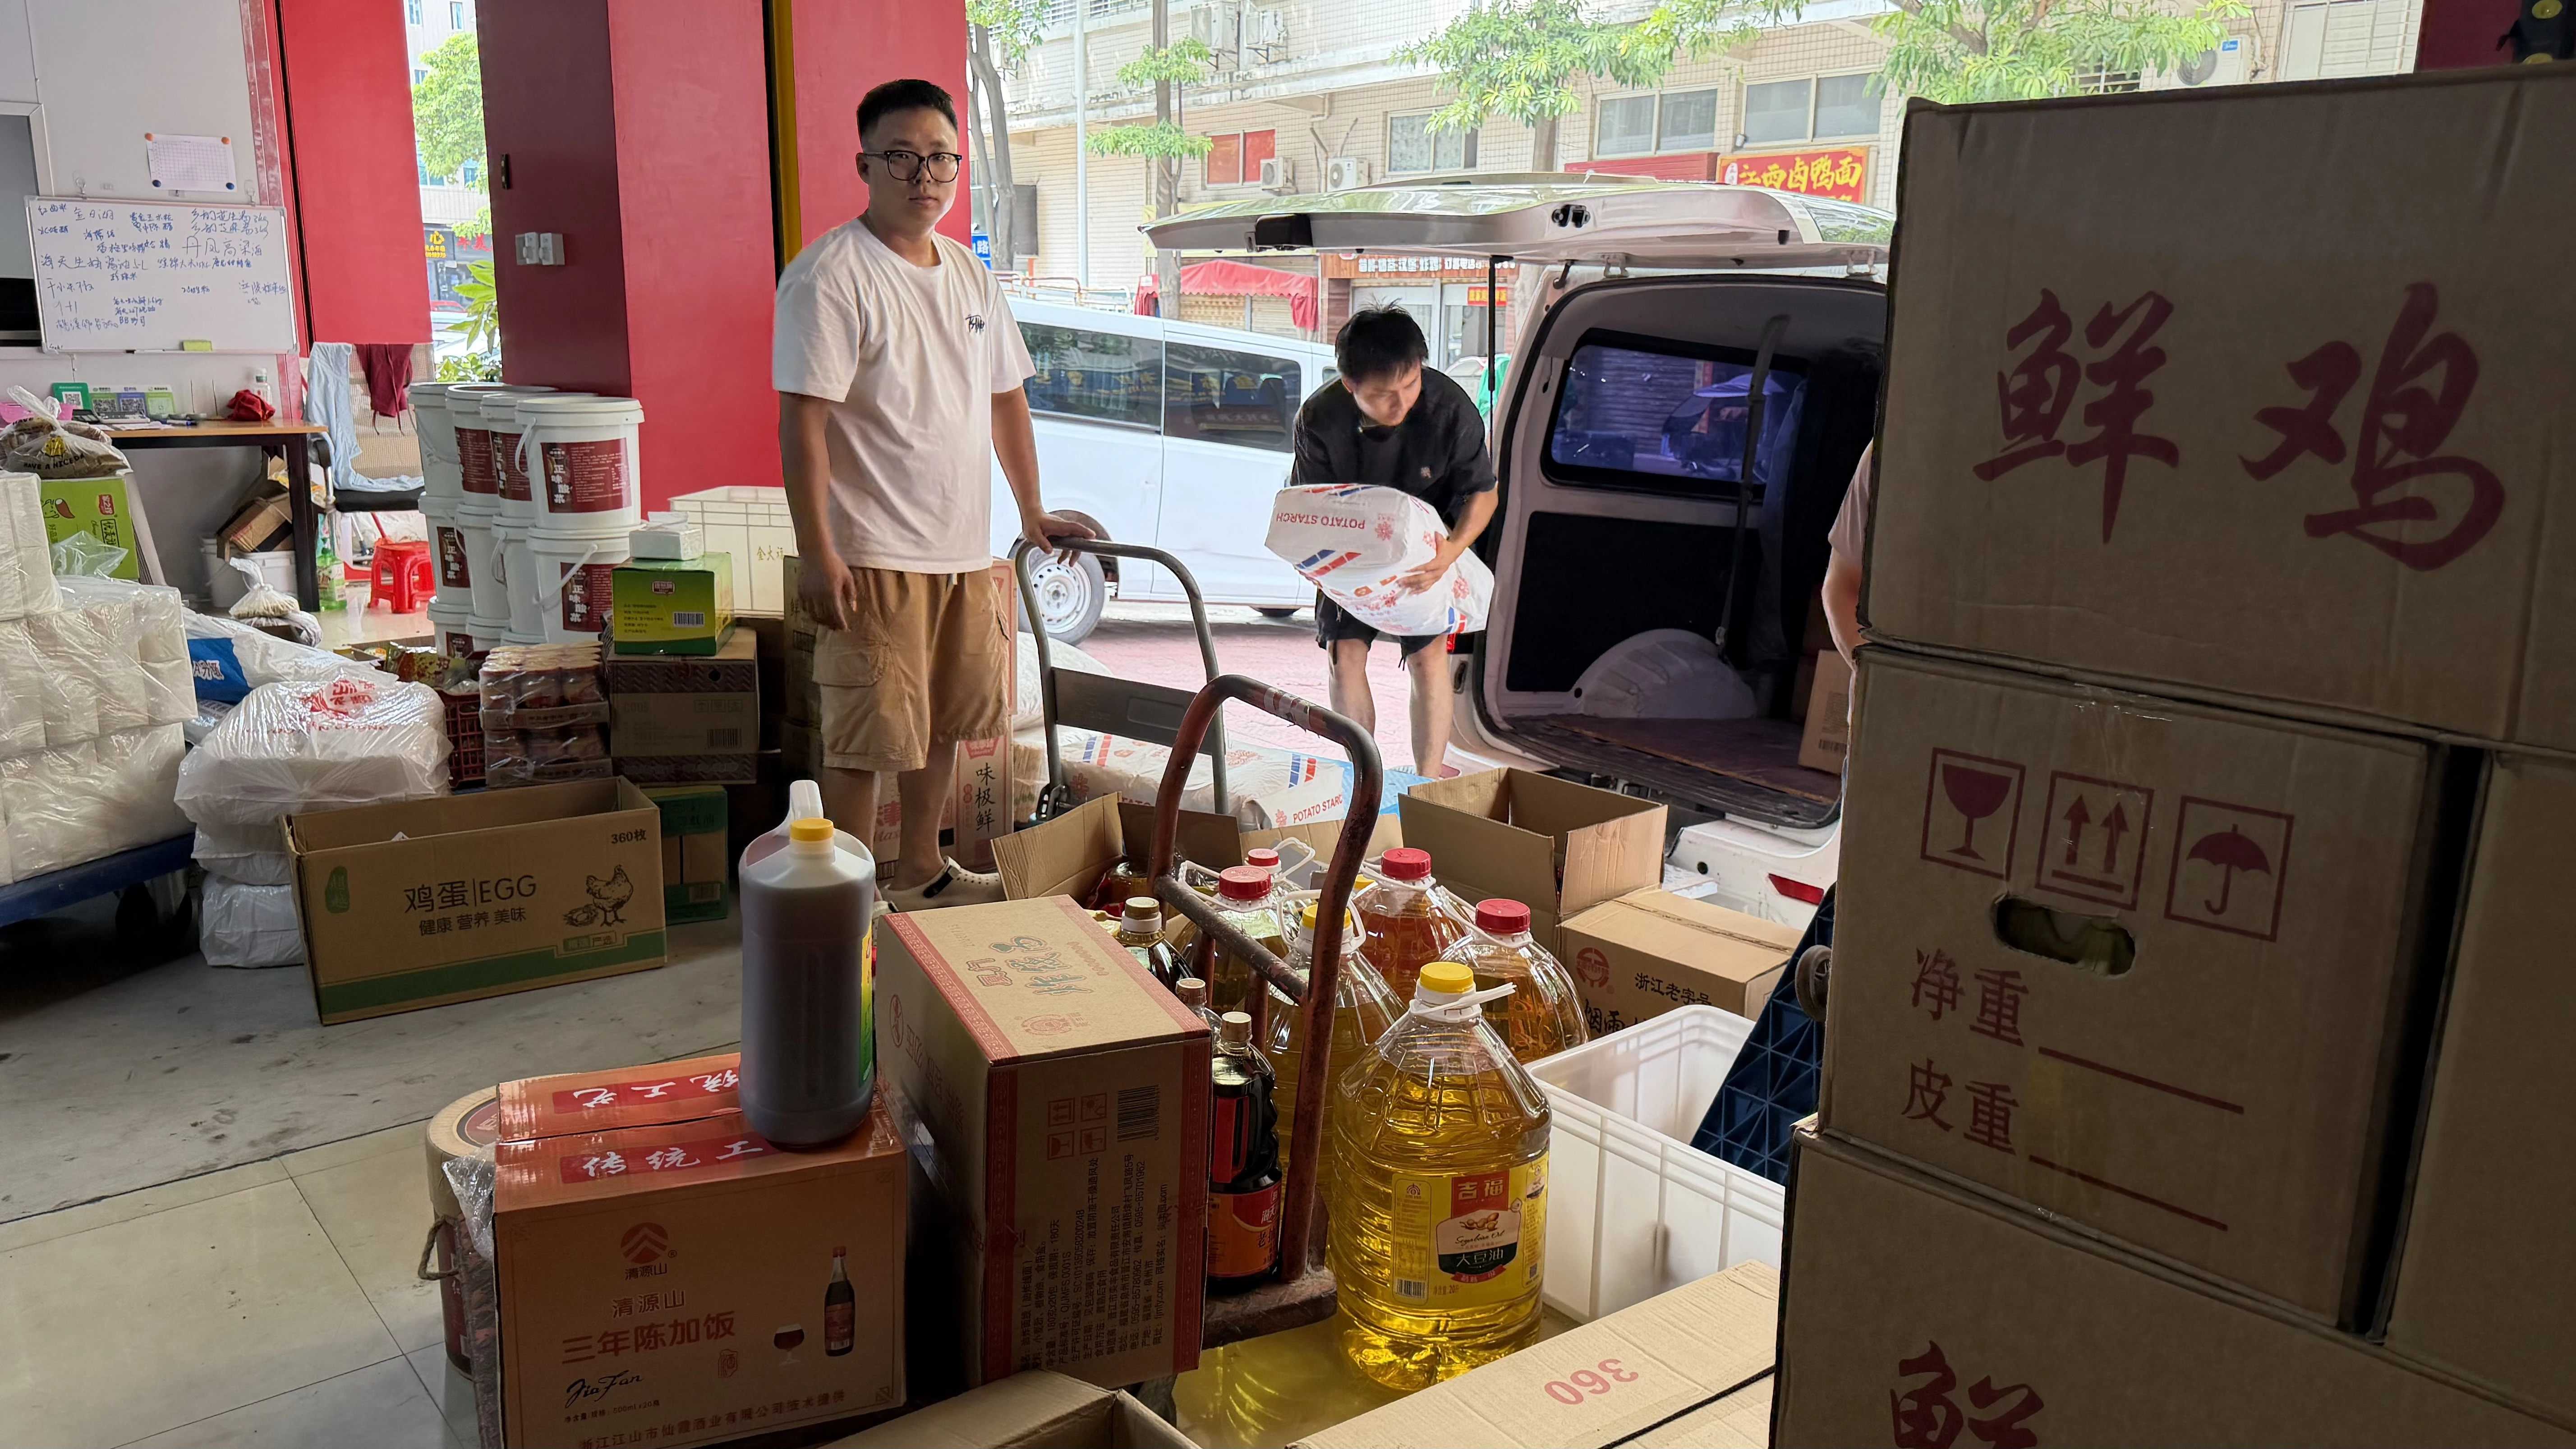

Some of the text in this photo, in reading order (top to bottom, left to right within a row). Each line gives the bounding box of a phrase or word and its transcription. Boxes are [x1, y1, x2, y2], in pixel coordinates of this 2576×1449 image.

[1739, 155, 1863, 193] 江西卤鸭面
[972, 239, 989, 254] 路
[1973, 281, 2505, 572] 鲜鸡
[1276, 512, 1365, 529] POTATO STARCH
[975, 762, 996, 833] 味极鲜
[1293, 804, 1321, 823] POTATO
[611, 829, 647, 844] 360枚
[404, 875, 536, 913] 鸡蛋 EGG
[419, 907, 526, 936] 健康 营养 美味
[1634, 972, 1712, 1006] 浙江老字号
[1911, 948, 2029, 1046] 净重
[1902, 1058, 2019, 1156] 皮重
[583, 1140, 764, 1178] 传统工
[1458, 1177, 1504, 1201] 吉福
[625, 1262, 667, 1281] 清源山
[1456, 1247, 1504, 1268] 大豆油
[611, 1289, 686, 1320] 清源山
[562, 1310, 736, 1366] 三年陈加饭
[1543, 1357, 1640, 1406] 360
